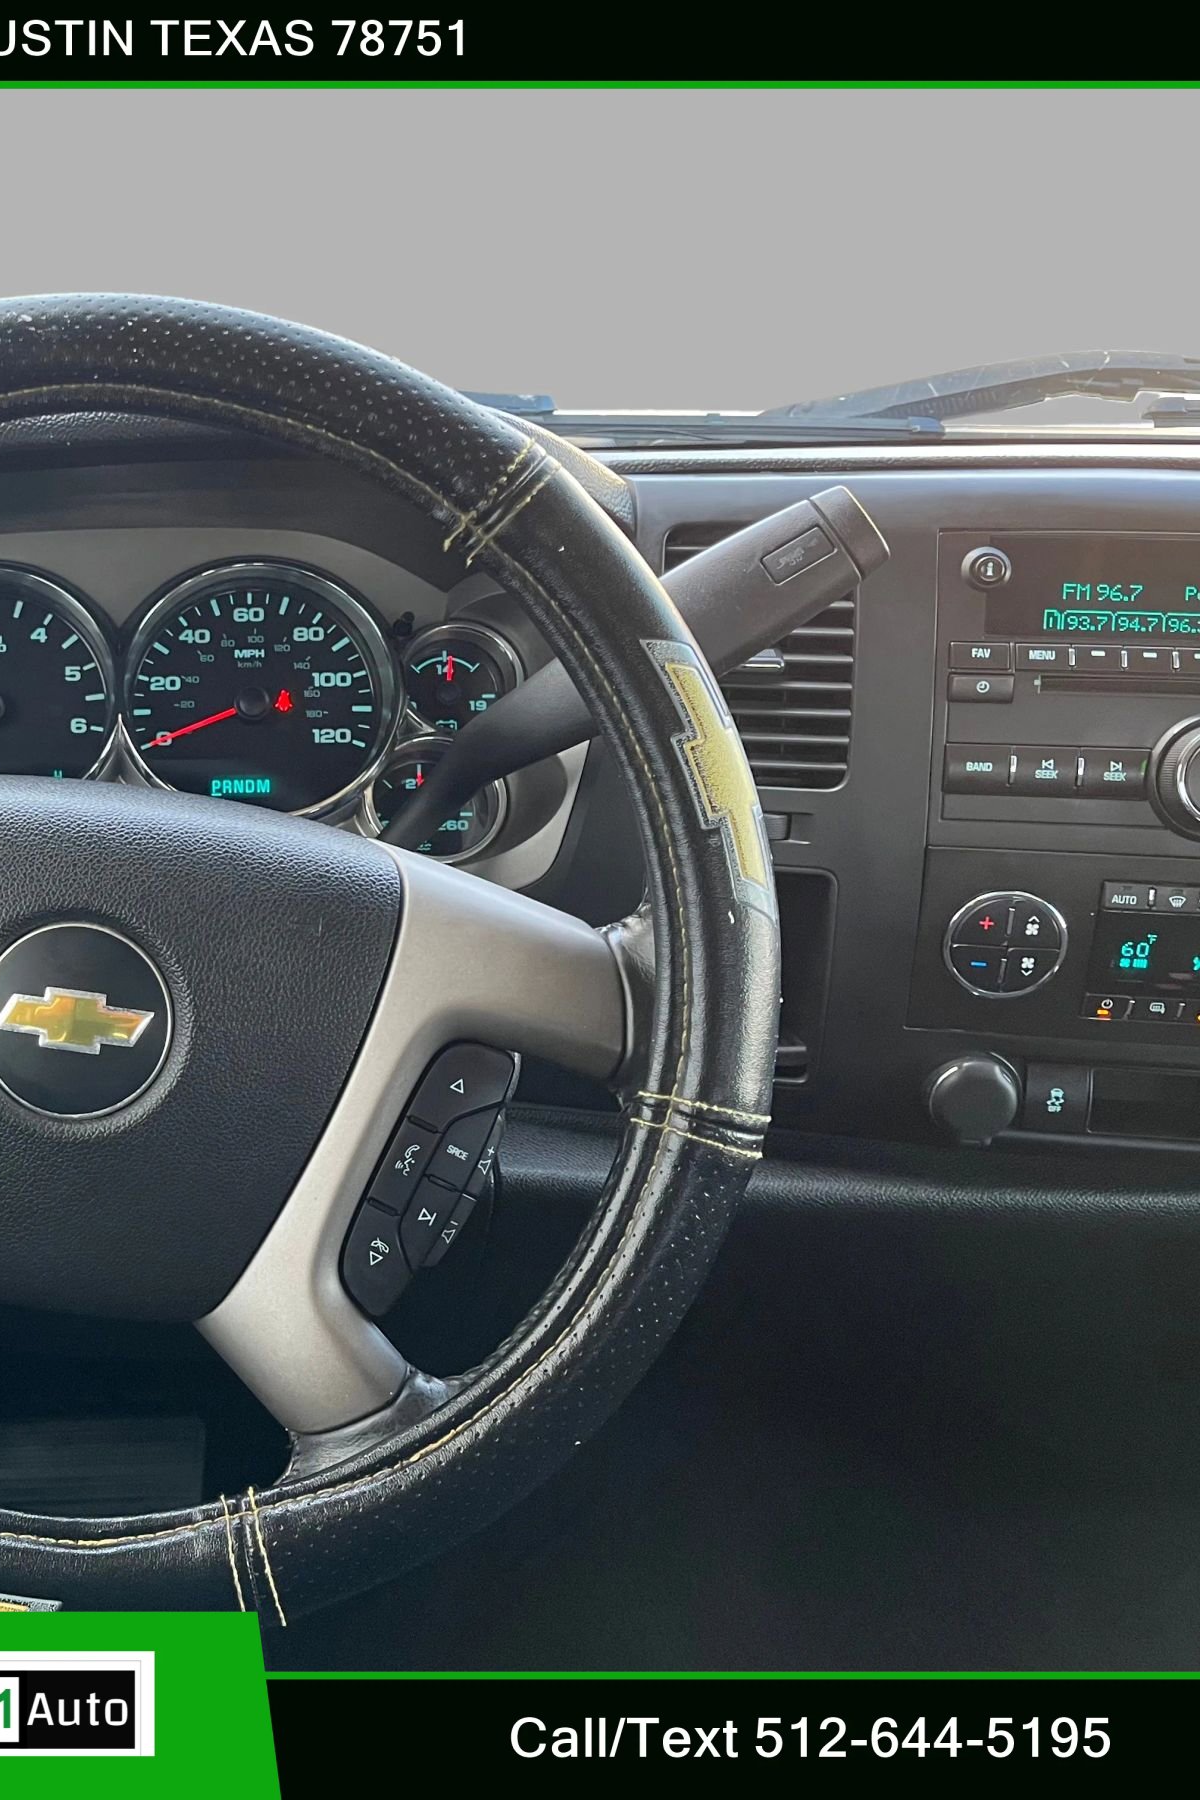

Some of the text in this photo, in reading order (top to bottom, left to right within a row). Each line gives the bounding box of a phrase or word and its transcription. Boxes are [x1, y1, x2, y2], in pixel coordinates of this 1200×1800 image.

[1062, 583, 1200, 602] FM 96.7 P
[233, 607, 265, 622] 60
[1066, 615, 1108, 632] 93.7
[1117, 617, 1159, 633] 94.7
[30, 628, 47, 644] 4
[178, 629, 211, 644] 40
[247, 635, 265, 644] 100
[292, 627, 325, 642] 80
[220, 639, 236, 648] 80
[273, 644, 291, 652] 120
[199, 654, 215, 663] 60
[234, 649, 265, 659] MPH
[971, 647, 991, 658] FAV
[1028, 649, 1056, 661] MENU
[237, 660, 263, 669] km/h
[293, 662, 311, 670] 140
[64, 667, 81, 683] 5
[184, 676, 200, 684] 40
[311, 671, 352, 688] 100
[149, 676, 182, 692] 20
[303, 689, 321, 698] 160
[179, 700, 195, 709] 20
[469, 700, 488, 712] 19
[70, 719, 87, 734] 6
[155, 730, 173, 746] 0
[311, 728, 352, 744] 120
[965, 761, 993, 772] BAND
[1034, 769, 1059, 779] SEEK
[1103, 771, 1127, 782] SEEK
[211, 779, 271, 796] PRNDM
[1111, 894, 1137, 905] AUTO
[1121, 941, 1150, 958] 60
[1047, 1105, 1062, 1113] OFF
[446, 1144, 469, 1161] SRCE
